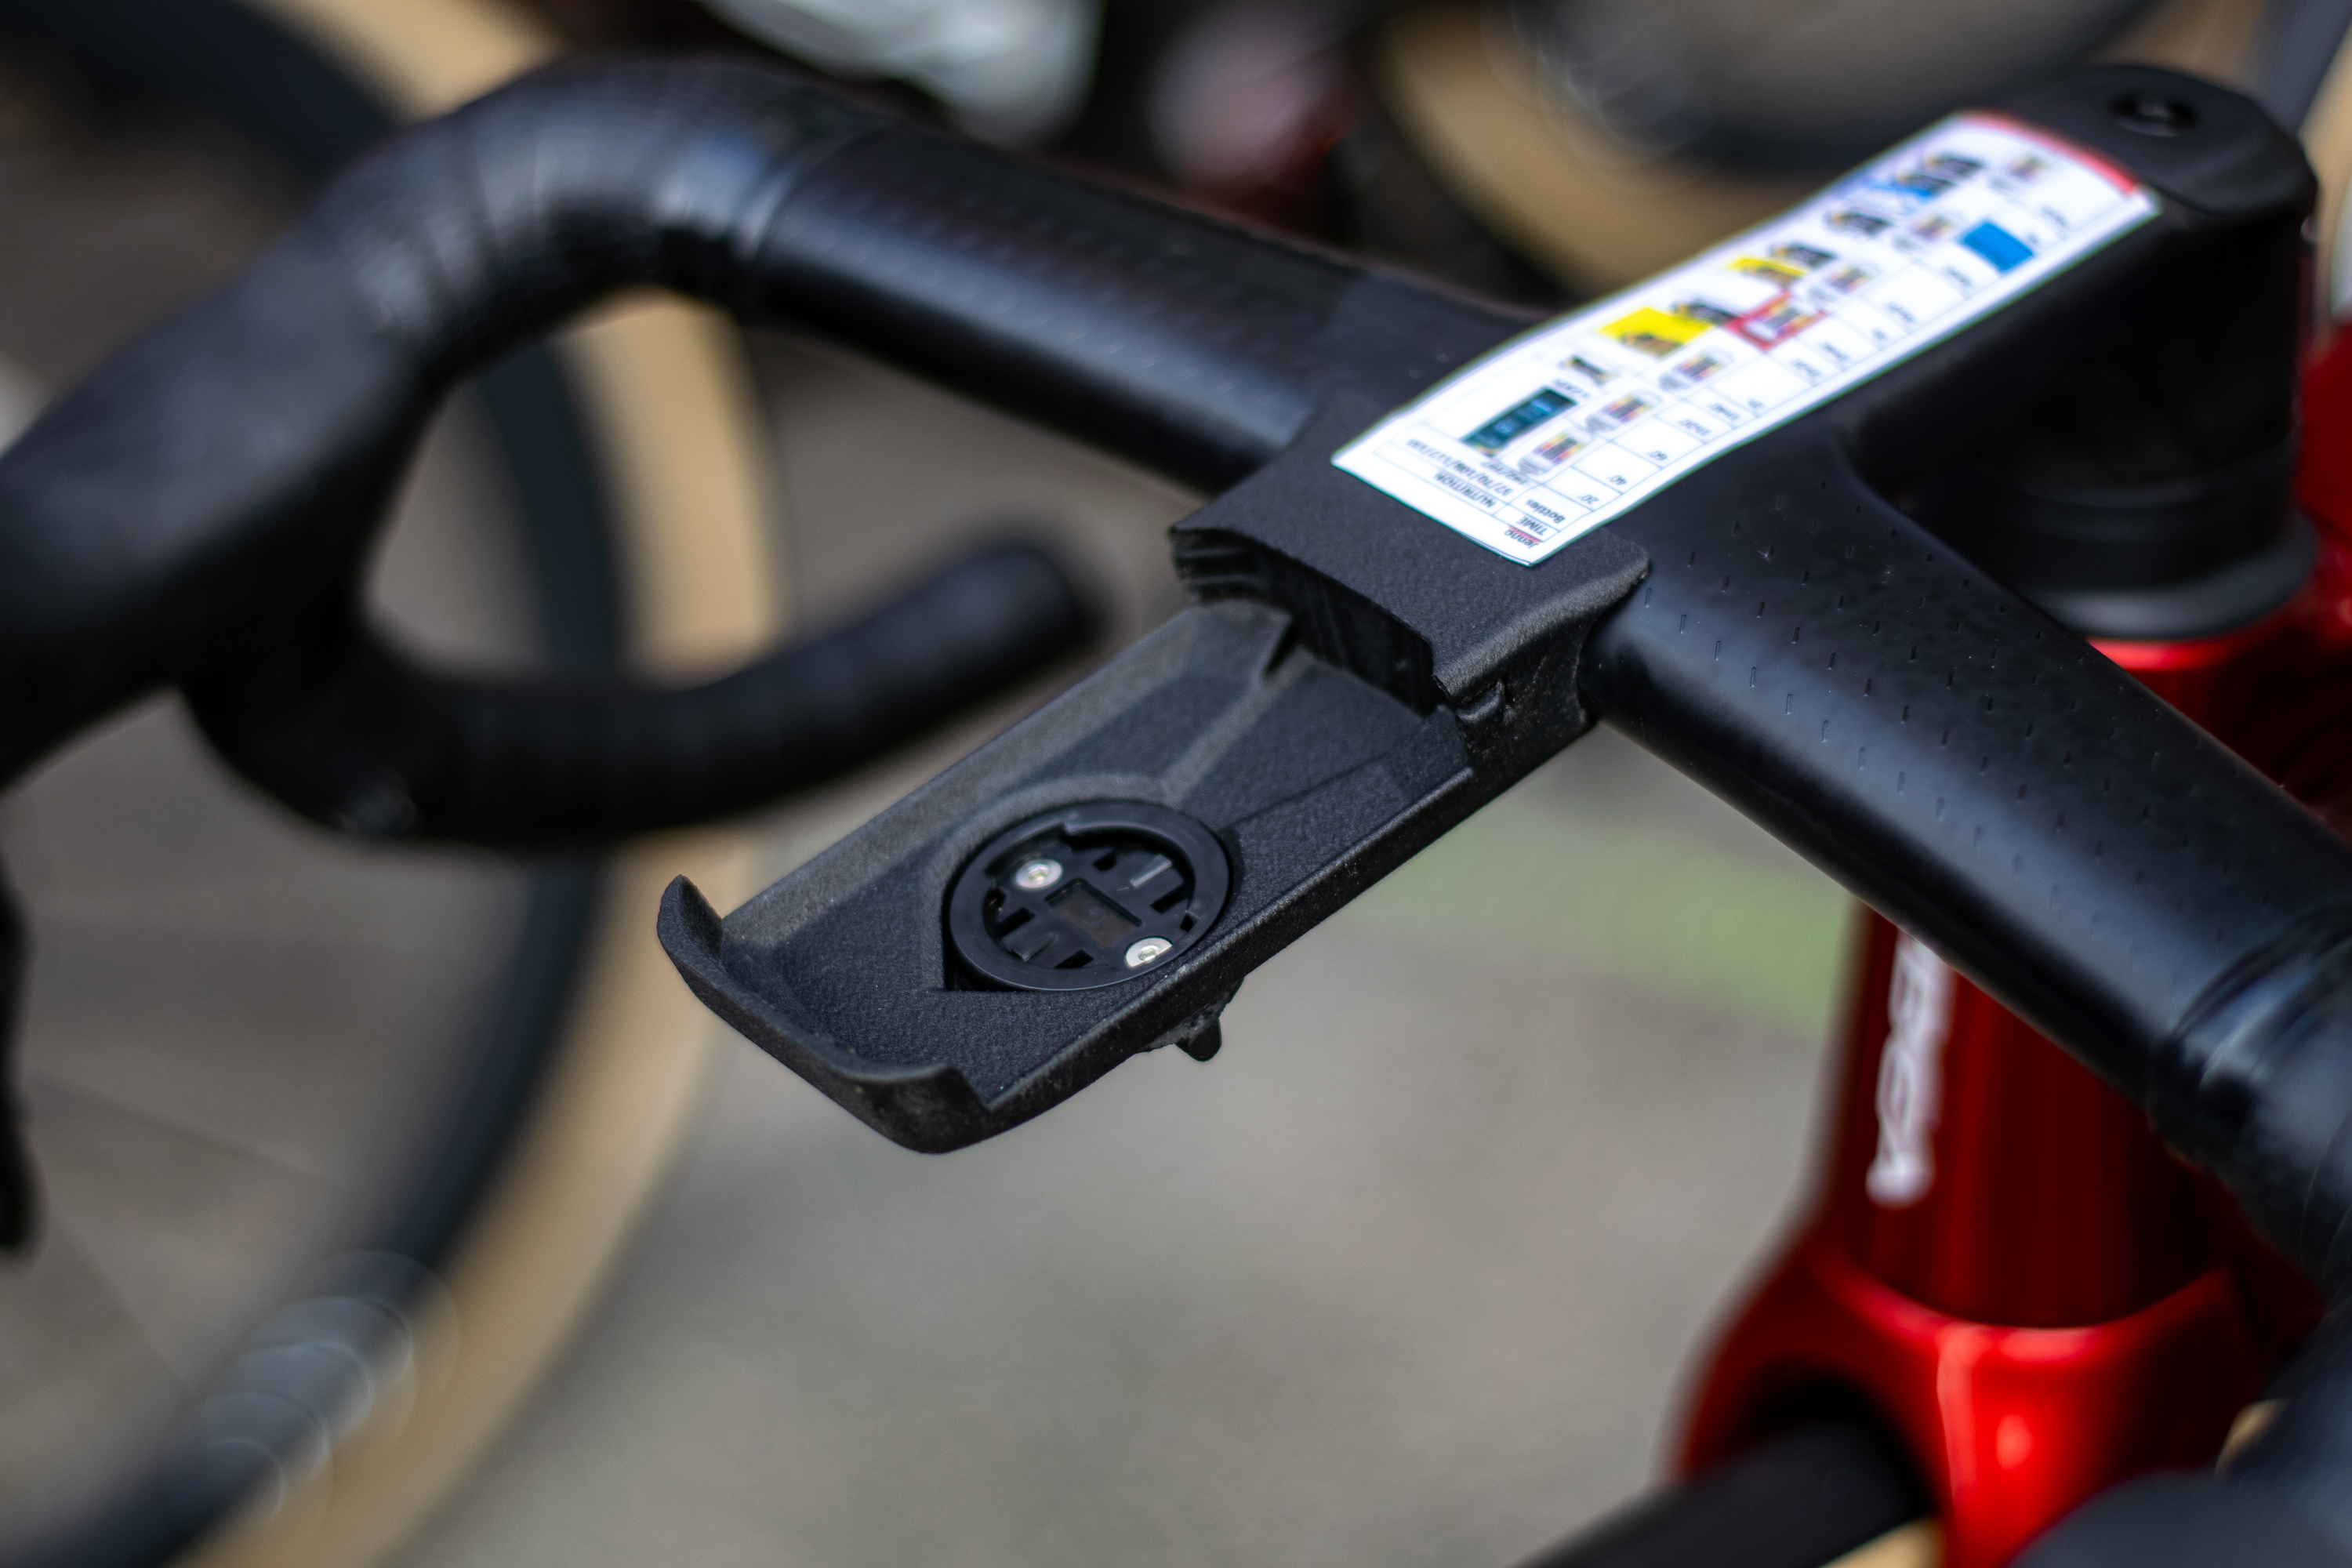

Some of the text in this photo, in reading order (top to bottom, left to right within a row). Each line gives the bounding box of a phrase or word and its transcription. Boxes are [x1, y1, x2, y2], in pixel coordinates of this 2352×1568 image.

[1433, 473, 1496, 508] NUTRITION
[1526, 499, 1566, 524] Bottles
[1516, 516, 1548, 536] TIME
[1504, 528, 1539, 549] Jenno
